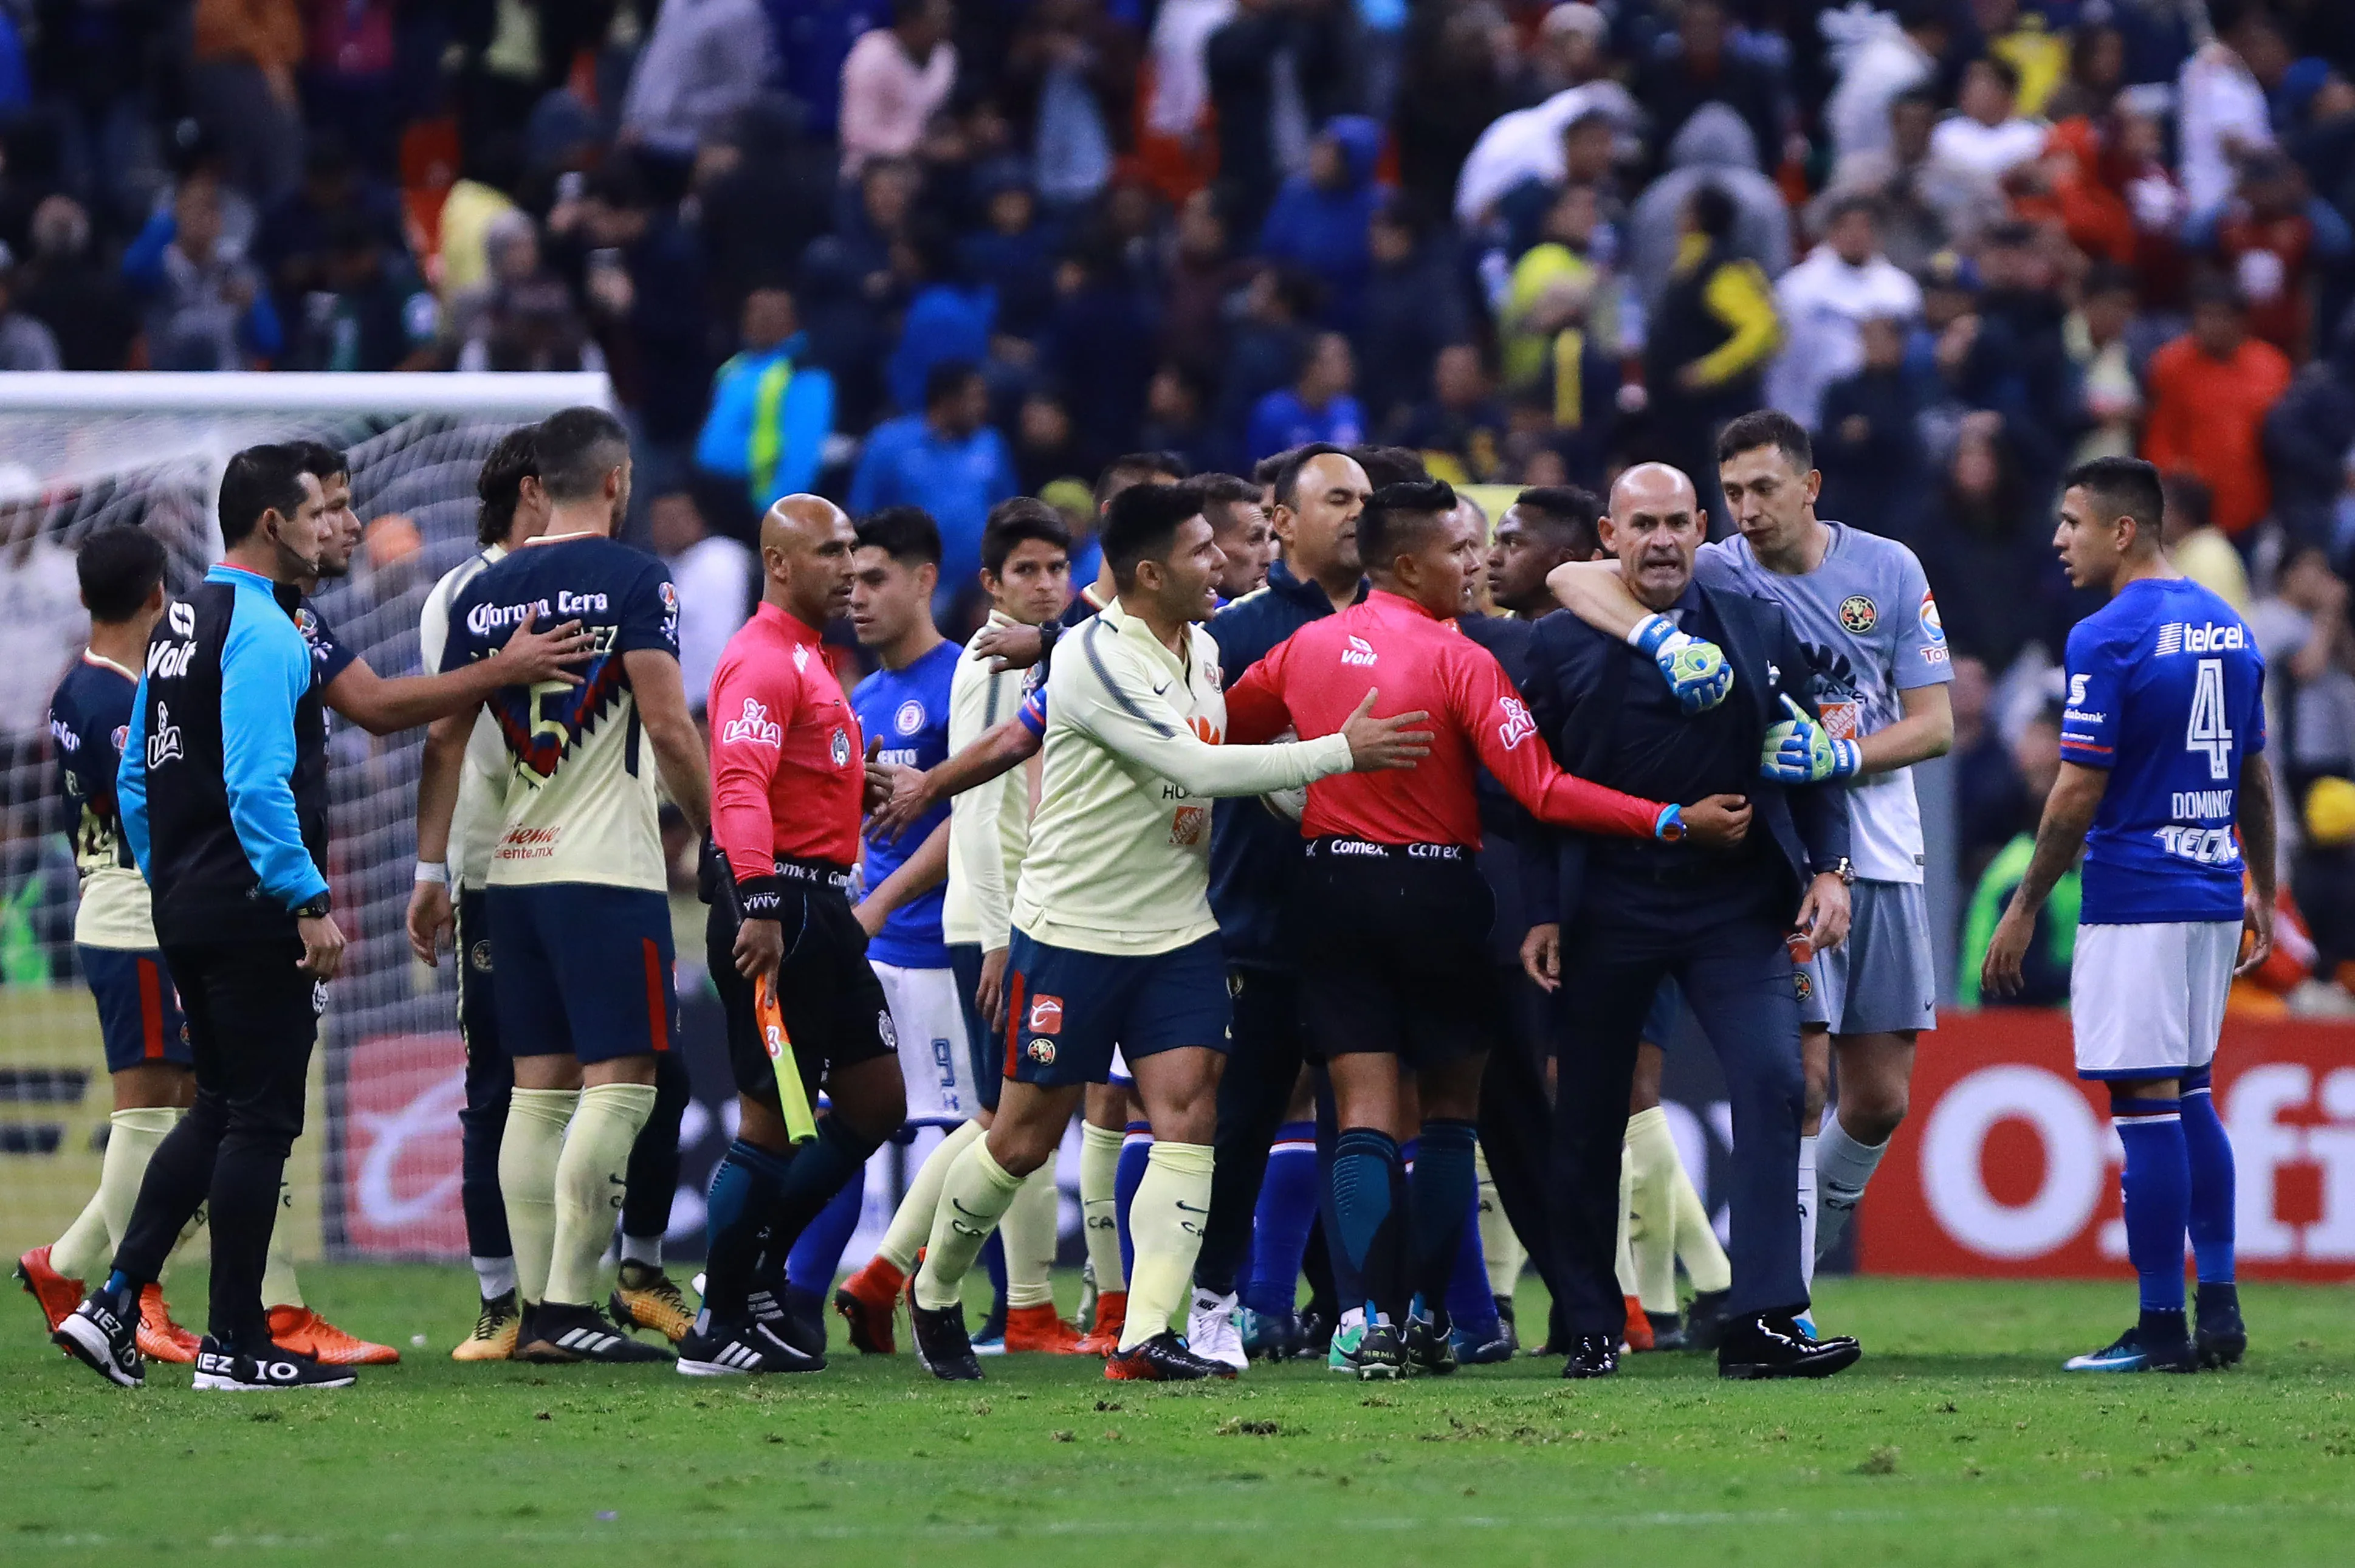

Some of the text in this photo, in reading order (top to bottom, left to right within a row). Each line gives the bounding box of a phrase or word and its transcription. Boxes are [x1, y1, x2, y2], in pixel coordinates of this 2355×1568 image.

[467, 602, 551, 634] Coroa
[2184, 621, 2243, 651] telcel
[147, 640, 198, 679] Voit
[1341, 649, 1378, 665] Voit
[1920, 646, 1949, 663] TOT
[520, 680, 574, 789] 5
[2187, 658, 2233, 779] 4
[877, 748, 916, 765] ENTO
[930, 1037, 955, 1087] 9
